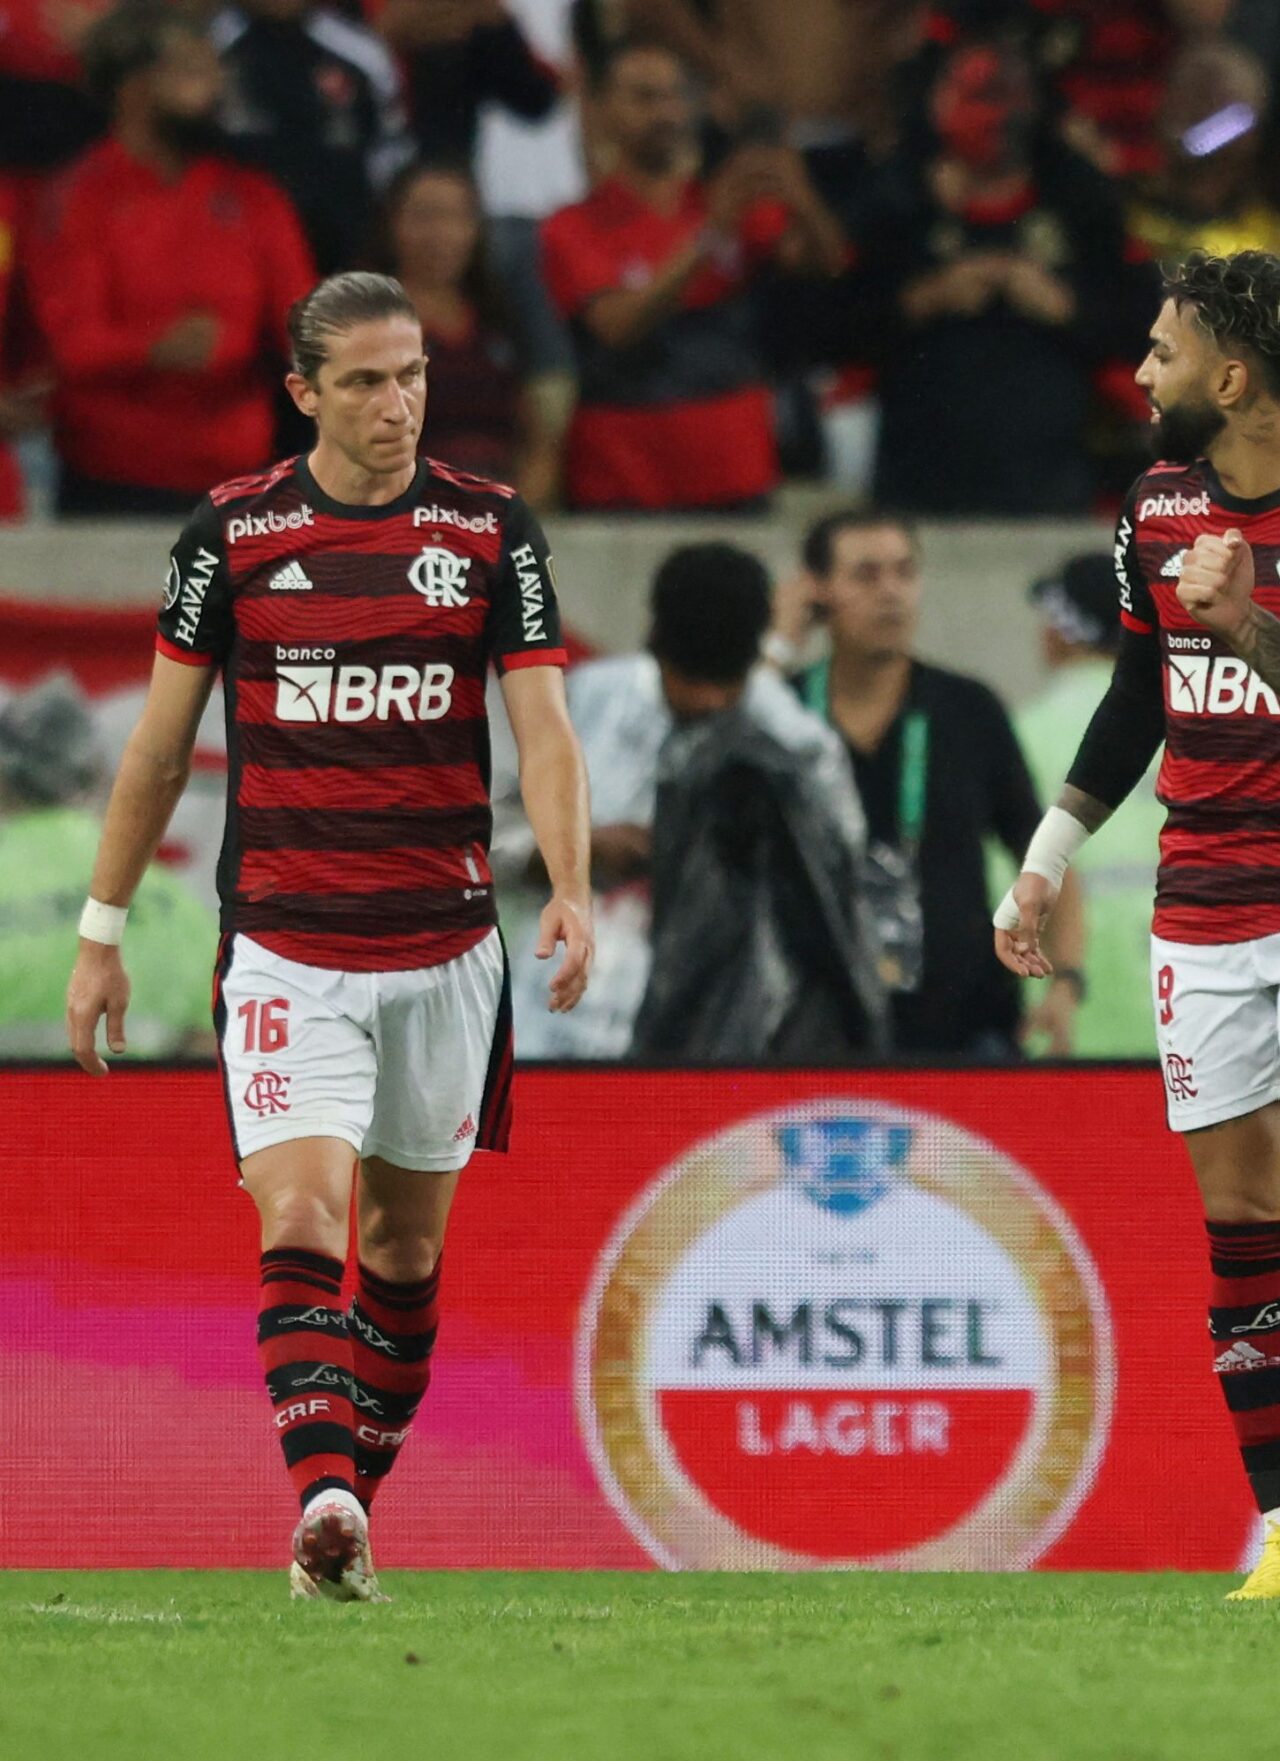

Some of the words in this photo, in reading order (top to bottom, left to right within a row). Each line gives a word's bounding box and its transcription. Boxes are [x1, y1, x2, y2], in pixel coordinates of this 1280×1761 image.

[227, 503, 315, 544] pixbet
[413, 504, 498, 535] pixbet
[1138, 491, 1210, 522] pixbet
[175, 547, 220, 647] HAVAN
[509, 543, 548, 642] HAVAN
[276, 645, 336, 661] banco
[1168, 633, 1211, 650] banco
[334, 664, 455, 722] BRB
[1158, 965, 1175, 1026] 9
[238, 997, 291, 1054] 16
[690, 1298, 1002, 1368] AMSTEL
[274, 1399, 330, 1428] CRF
[736, 1400, 951, 1456] LAGER
